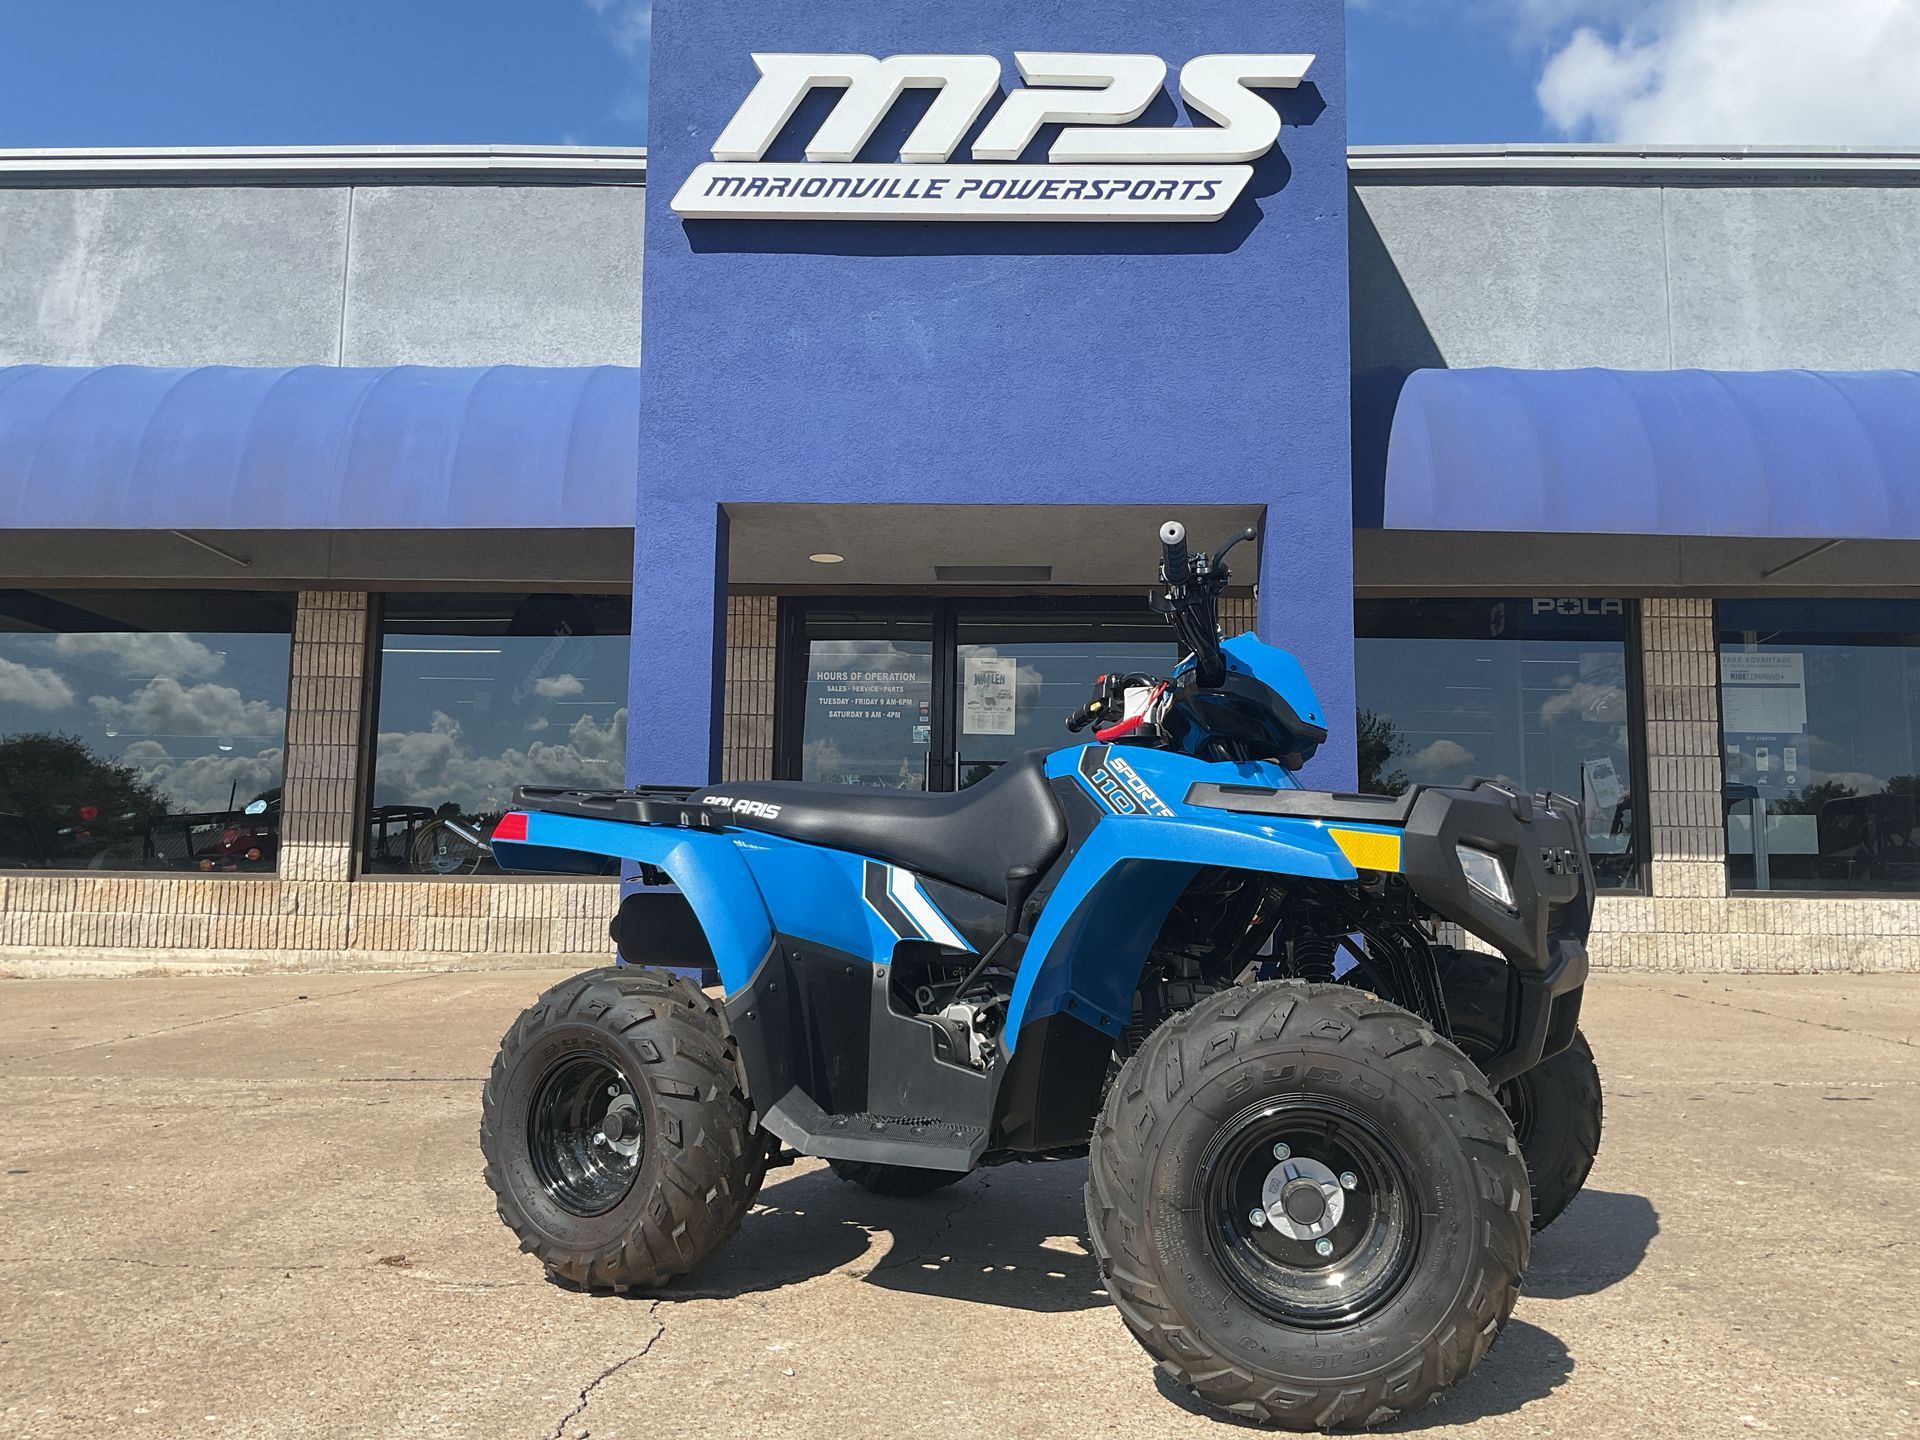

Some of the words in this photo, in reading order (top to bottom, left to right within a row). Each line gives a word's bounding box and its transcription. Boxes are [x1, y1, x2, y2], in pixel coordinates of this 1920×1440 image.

[711, 52, 1316, 162] MPS
[702, 176, 948, 200] MARIONVILLE
[955, 177, 1223, 201] POWERSPORTS
[816, 671, 848, 681] HOURS
[850, 672, 862, 681] OF
[864, 672, 916, 681] OPERATION
[818, 697, 850, 705] TUESDAY
[828, 710, 863, 718] SATURDAY
[1091, 768, 1137, 815] 110
[1109, 757, 1177, 817] SPORTS
[702, 795, 782, 819] POLARIS
